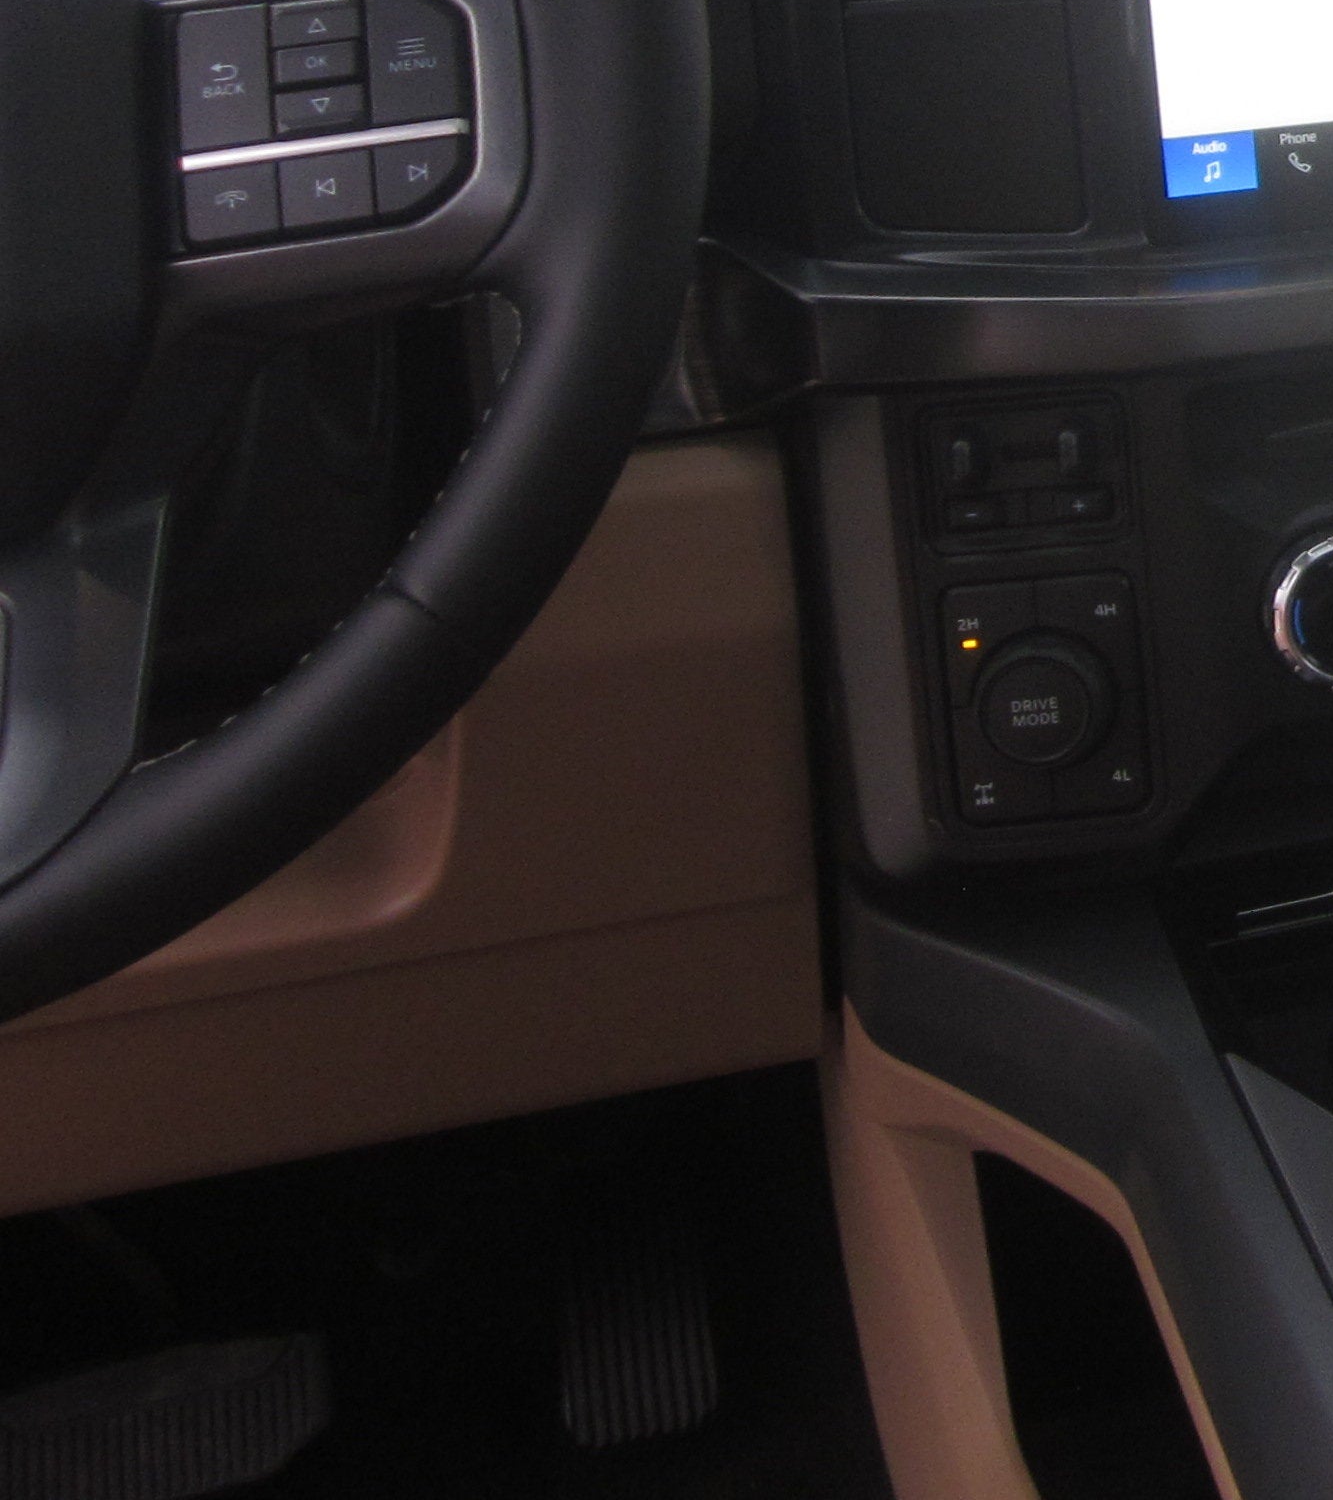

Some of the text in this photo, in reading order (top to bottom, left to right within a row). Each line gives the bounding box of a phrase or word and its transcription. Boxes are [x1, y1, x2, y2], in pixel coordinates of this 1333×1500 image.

[305, 55, 328, 69] OK
[389, 55, 437, 73] MENU
[202, 82, 246, 99] BACK
[1279, 132, 1318, 145] Phone
[1192, 140, 1227, 156] Audio
[1094, 603, 1117, 617] 4H
[957, 618, 980, 632] 2H
[1011, 696, 1059, 713] DRIVE
[1012, 711, 1060, 728] MODE
[1113, 769, 1131, 782] 4L
